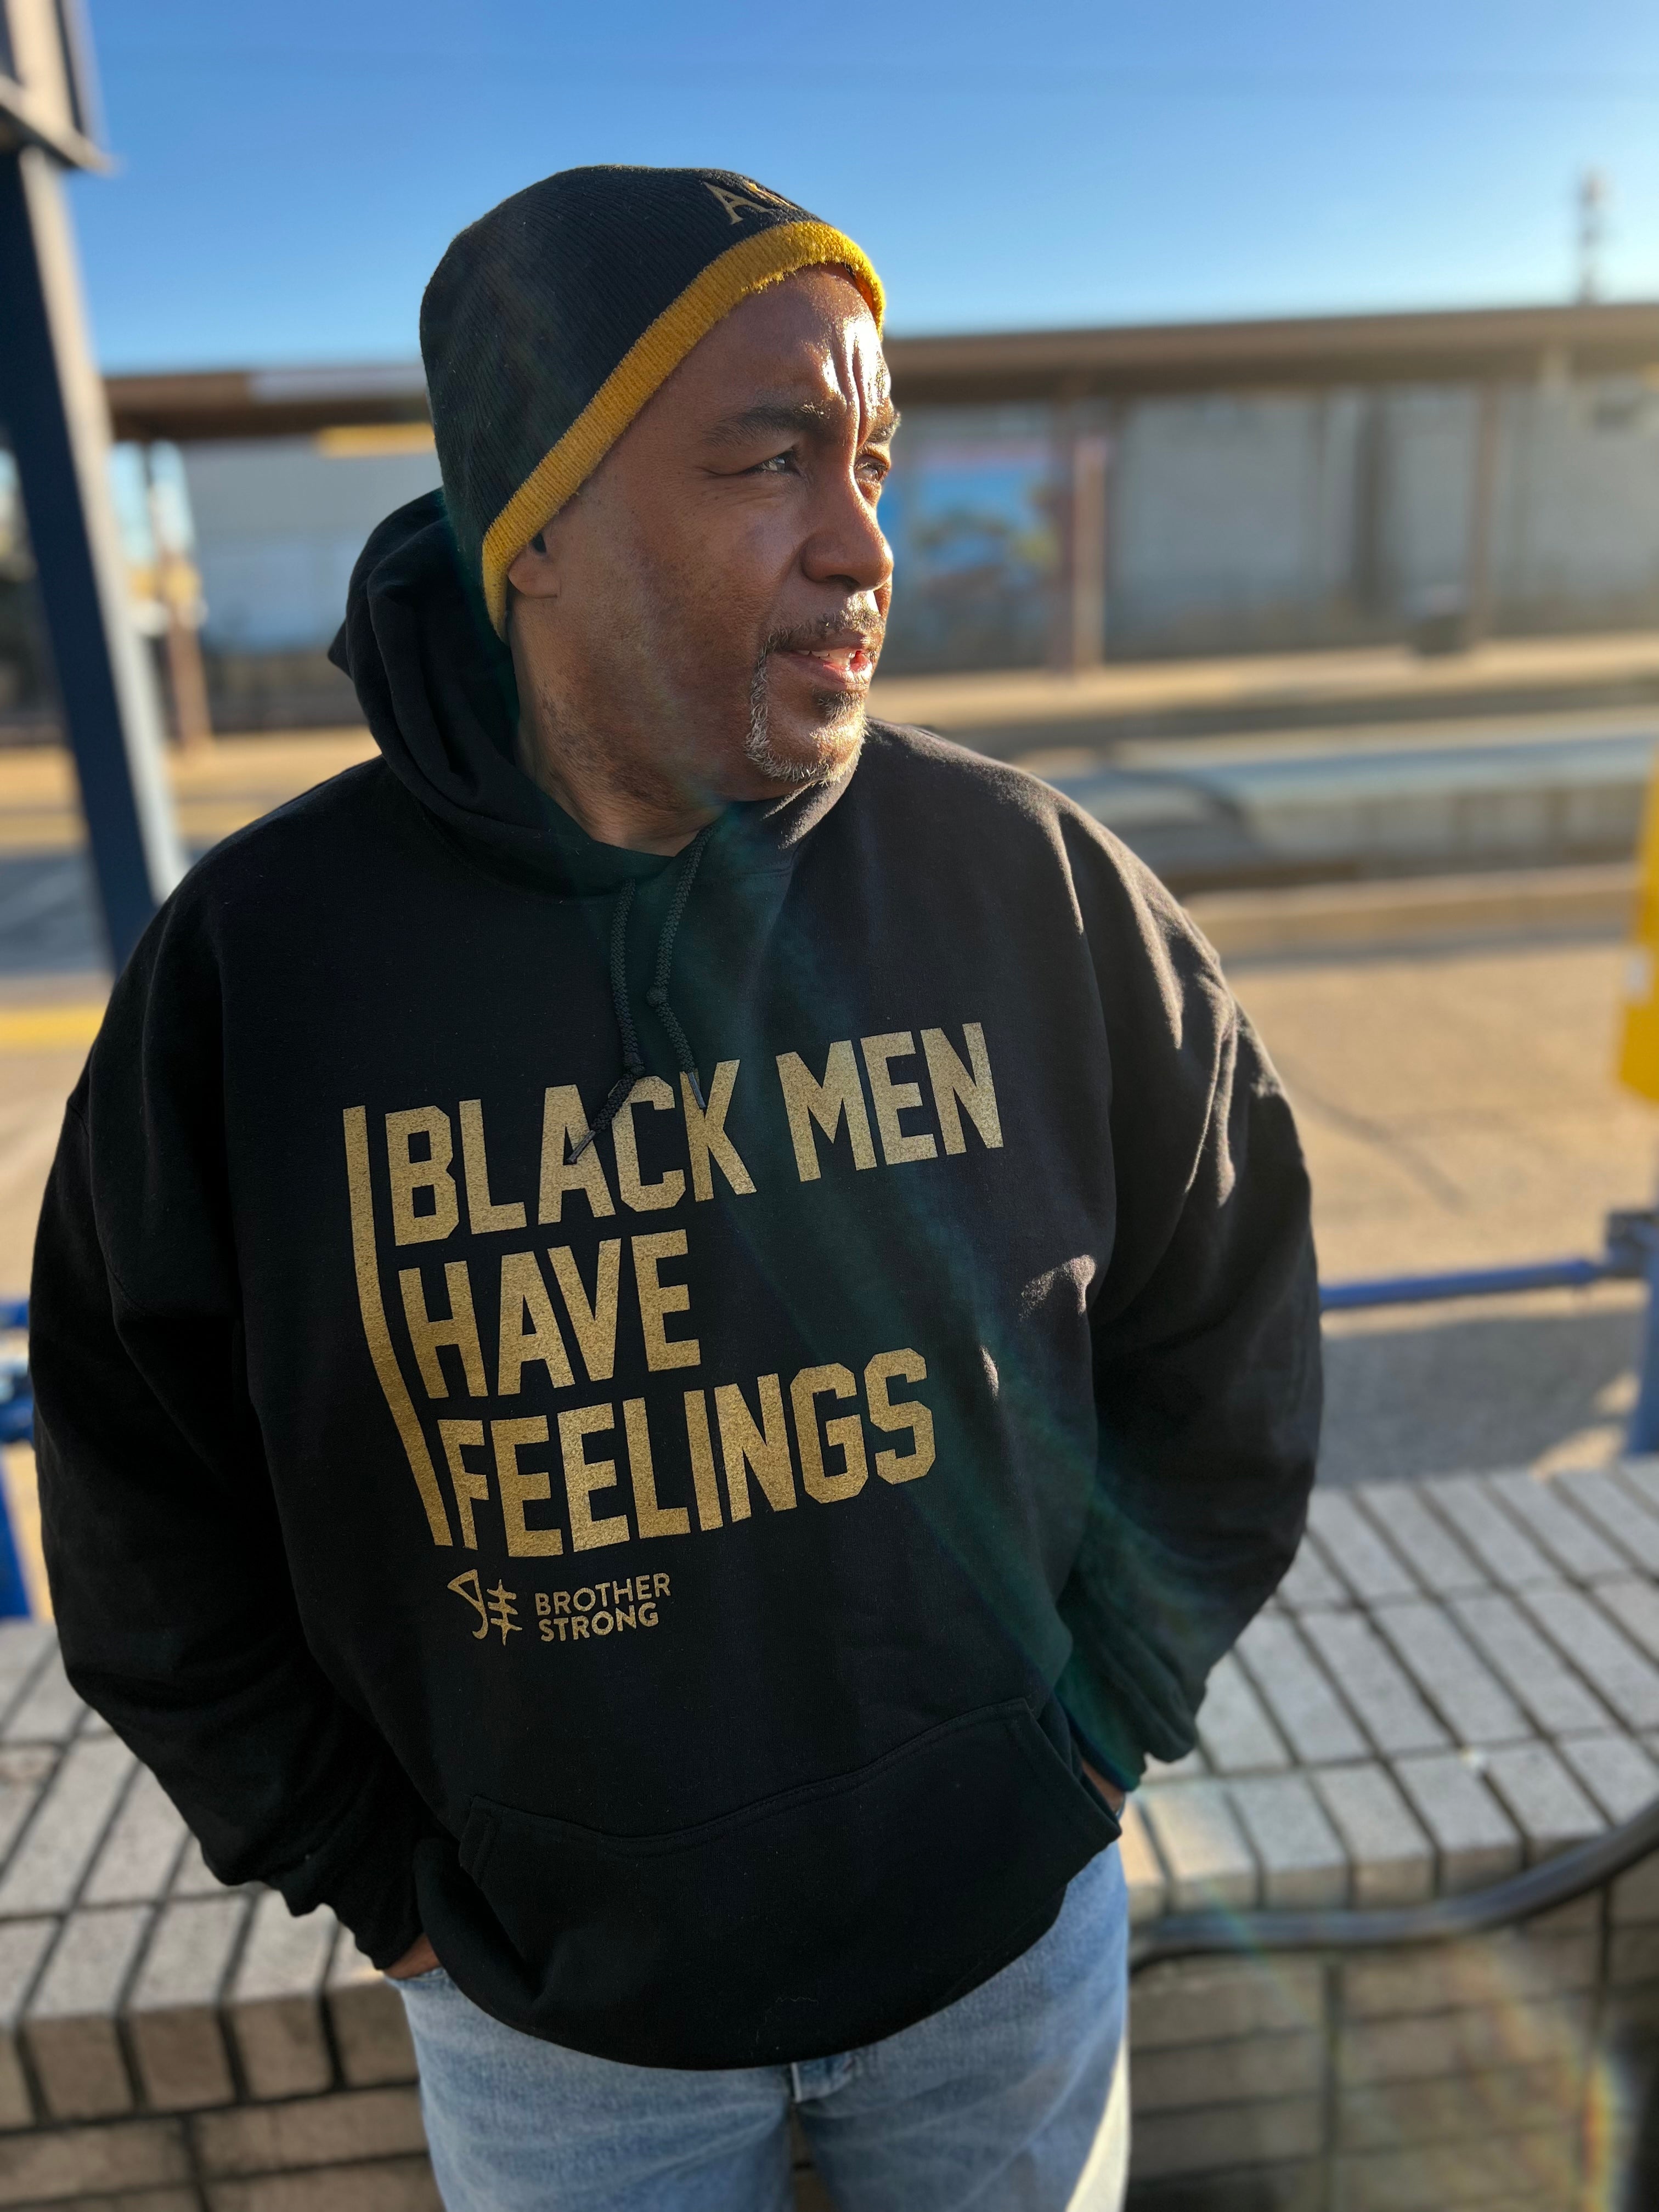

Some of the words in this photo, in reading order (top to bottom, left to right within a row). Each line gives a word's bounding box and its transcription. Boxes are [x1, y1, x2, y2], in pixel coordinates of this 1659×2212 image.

[386, 1059, 757, 1246] BLACK
[776, 1023, 1004, 1182] MEN
[398, 1229, 701, 1399] HAVE
[437, 1348, 936, 1558] FEELINGS
[534, 1573, 671, 1616] BROTHER
[538, 1601, 659, 1642] STRONG
